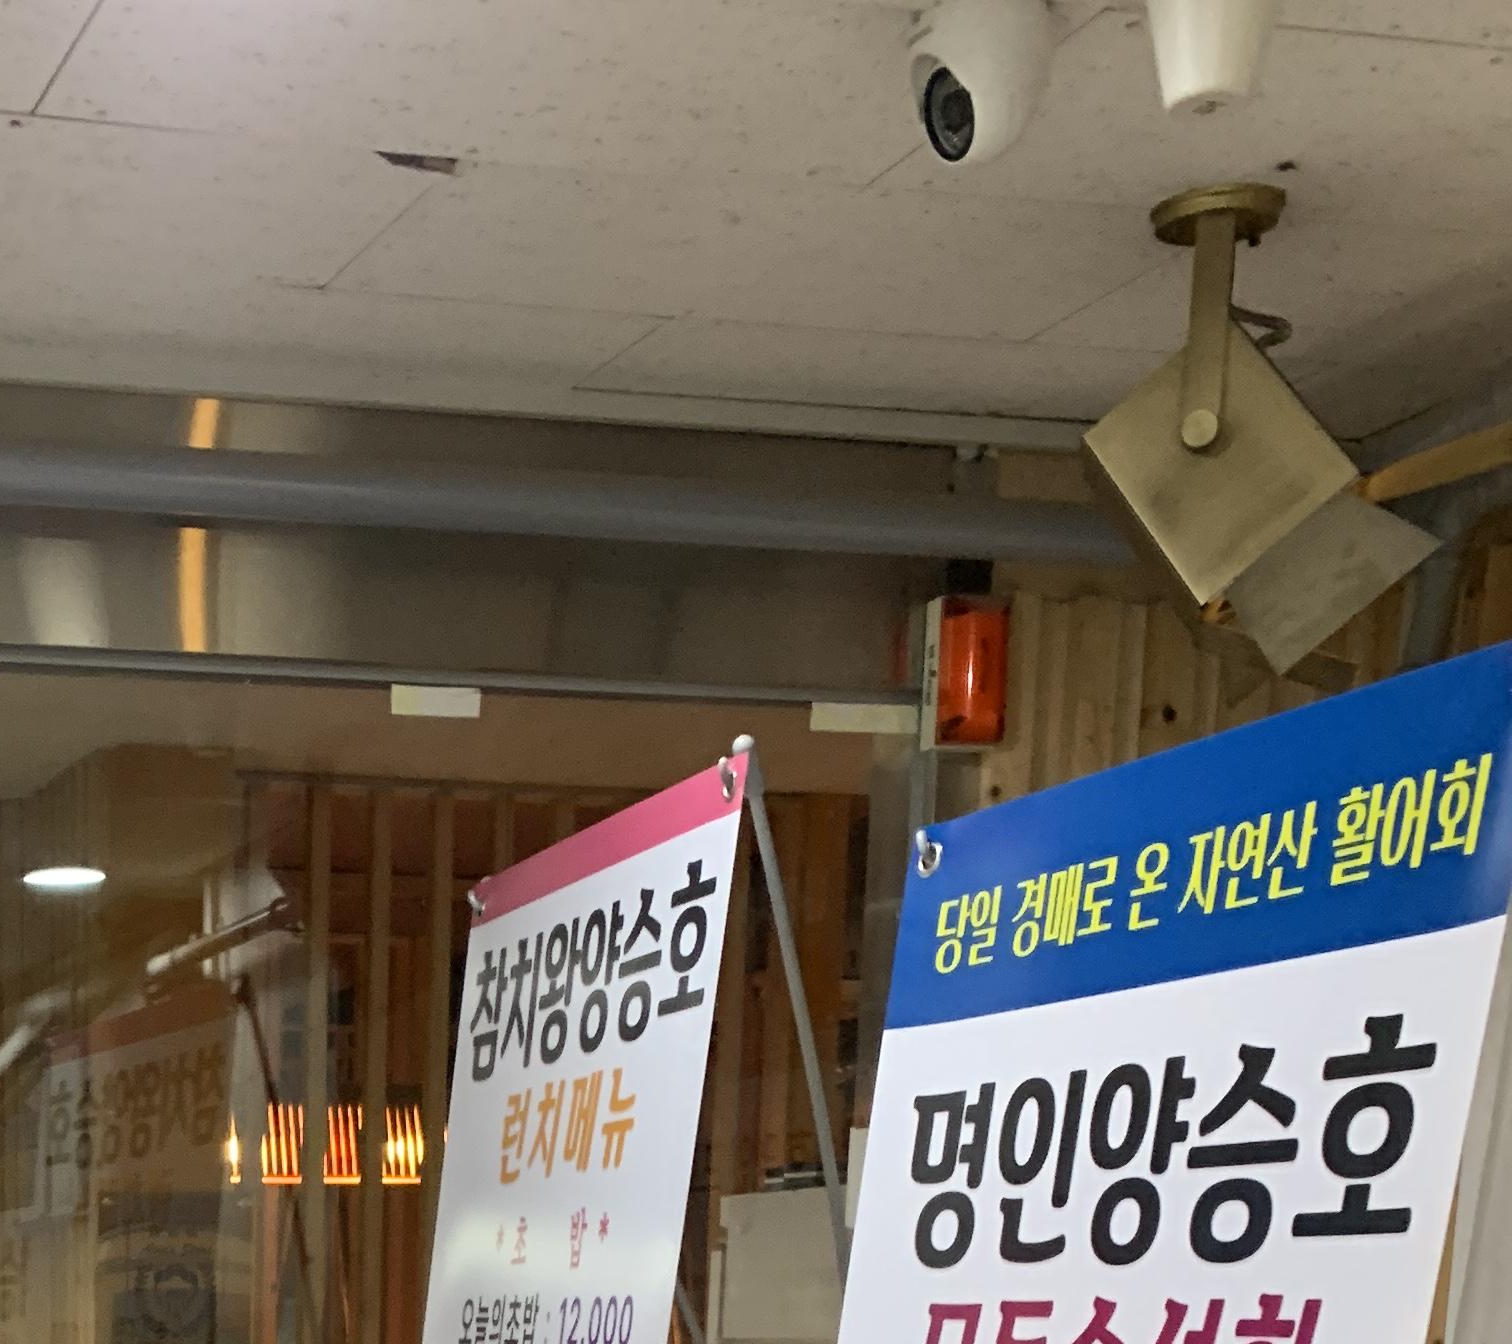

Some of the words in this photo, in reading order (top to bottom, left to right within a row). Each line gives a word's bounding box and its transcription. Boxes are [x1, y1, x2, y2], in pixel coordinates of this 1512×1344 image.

[470, 859, 717, 1082] 참치왕양승호
[934, 884, 1004, 974] 당일
[1011, 855, 1119, 958] 경매로
[1128, 842, 1168, 931] 온
[1178, 800, 1317, 914] 자연산
[1330, 754, 1493, 886] 활어회
[499, 1068, 636, 1184] 런치메뉴
[910, 1014, 1437, 1268] 명인양승호
